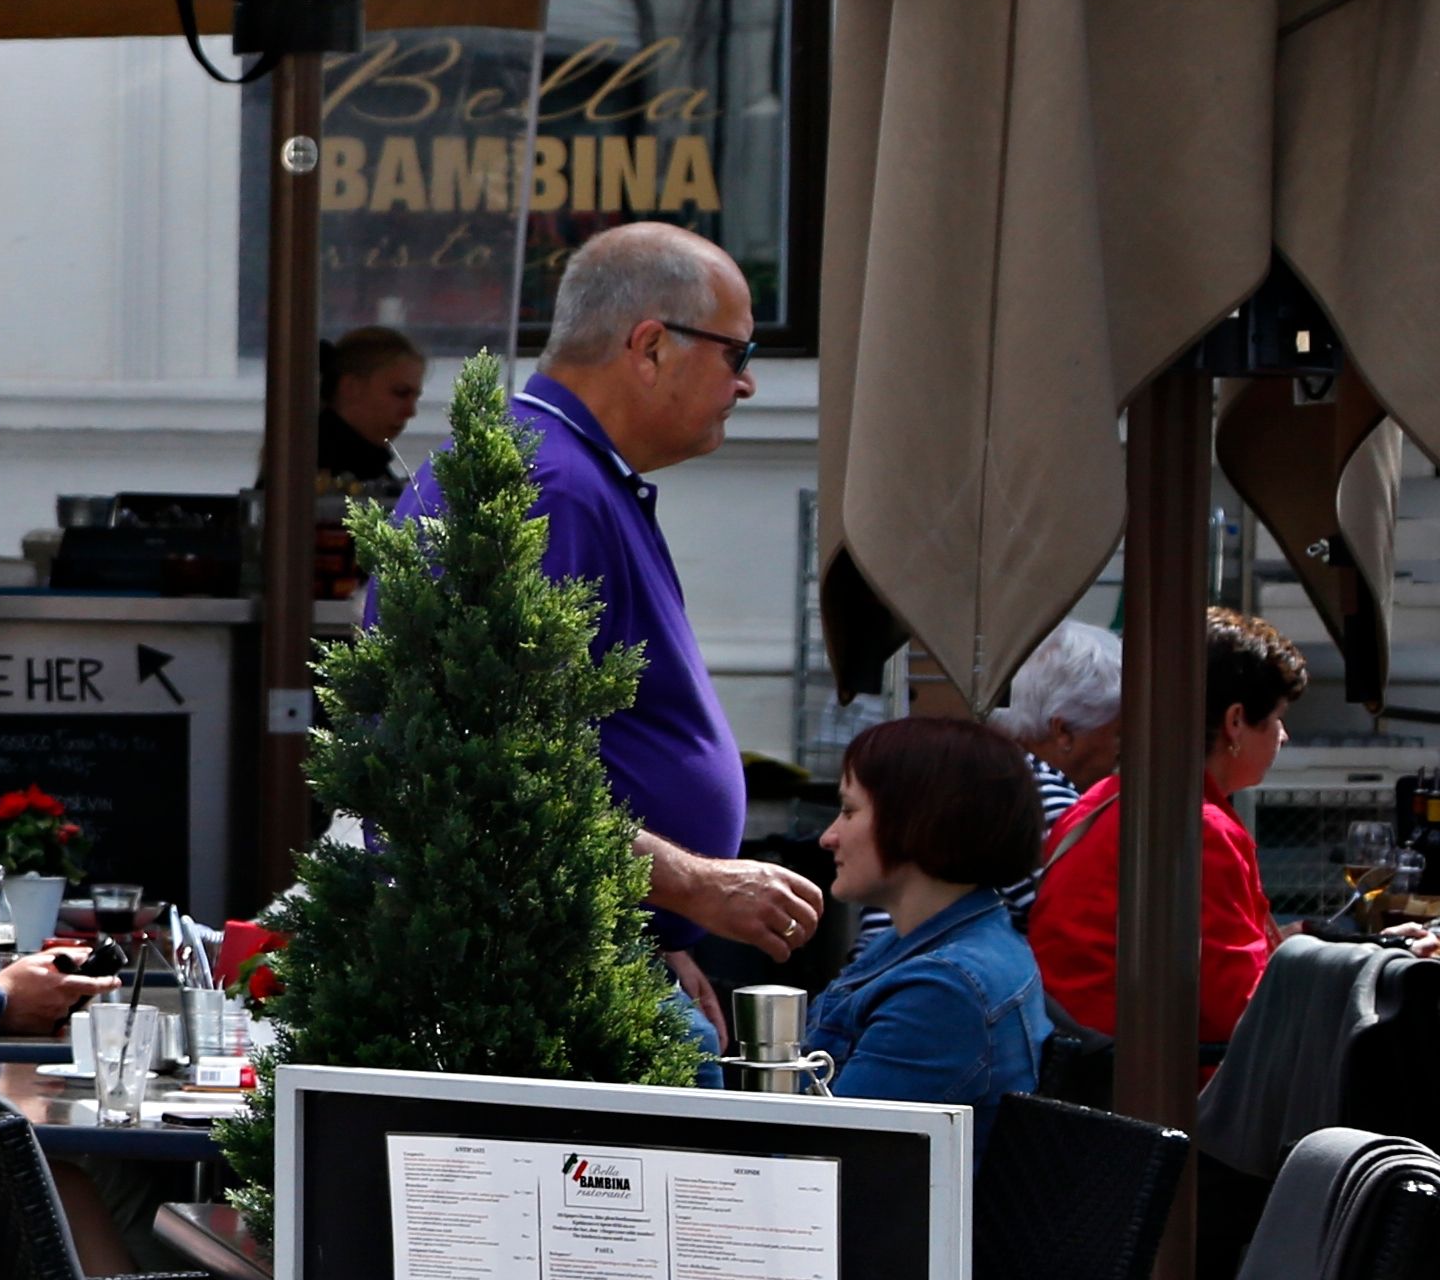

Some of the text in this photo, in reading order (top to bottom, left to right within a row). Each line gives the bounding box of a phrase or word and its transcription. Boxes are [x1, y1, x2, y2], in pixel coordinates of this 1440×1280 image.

[320, 134, 722, 214] BAMBINA
[26, 657, 105, 702] HER
[579, 1175, 631, 1191] BAMBINA
[588, 1163, 620, 1177] Bella
